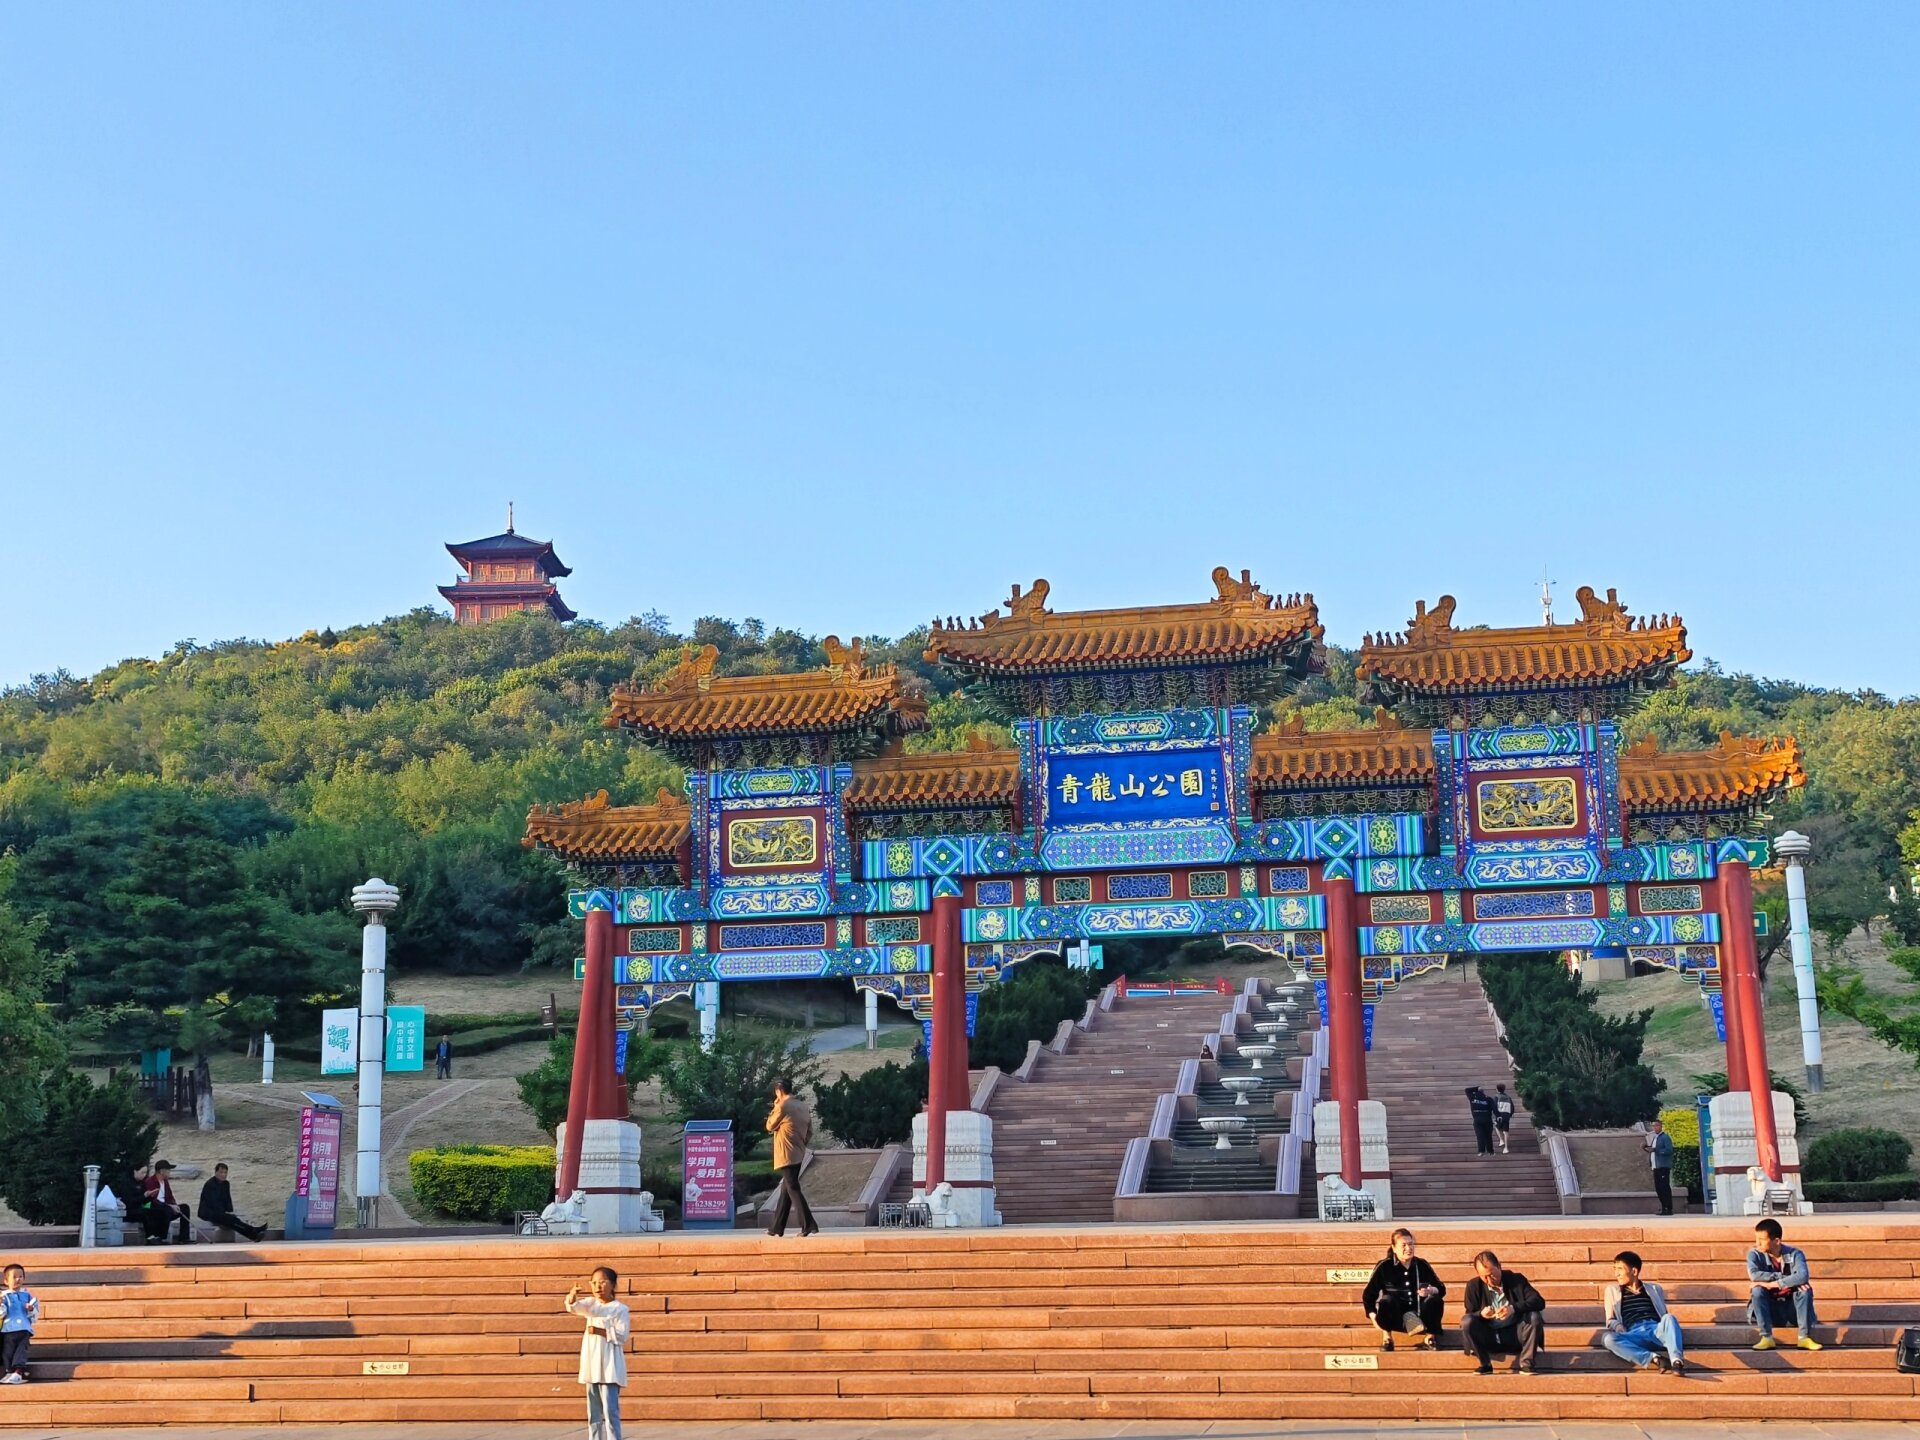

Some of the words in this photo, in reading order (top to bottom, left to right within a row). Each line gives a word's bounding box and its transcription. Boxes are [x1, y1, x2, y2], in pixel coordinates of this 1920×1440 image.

[1056, 768, 1204, 804] 青龍山公園
[694, 1200, 726, 1208] 6238299
